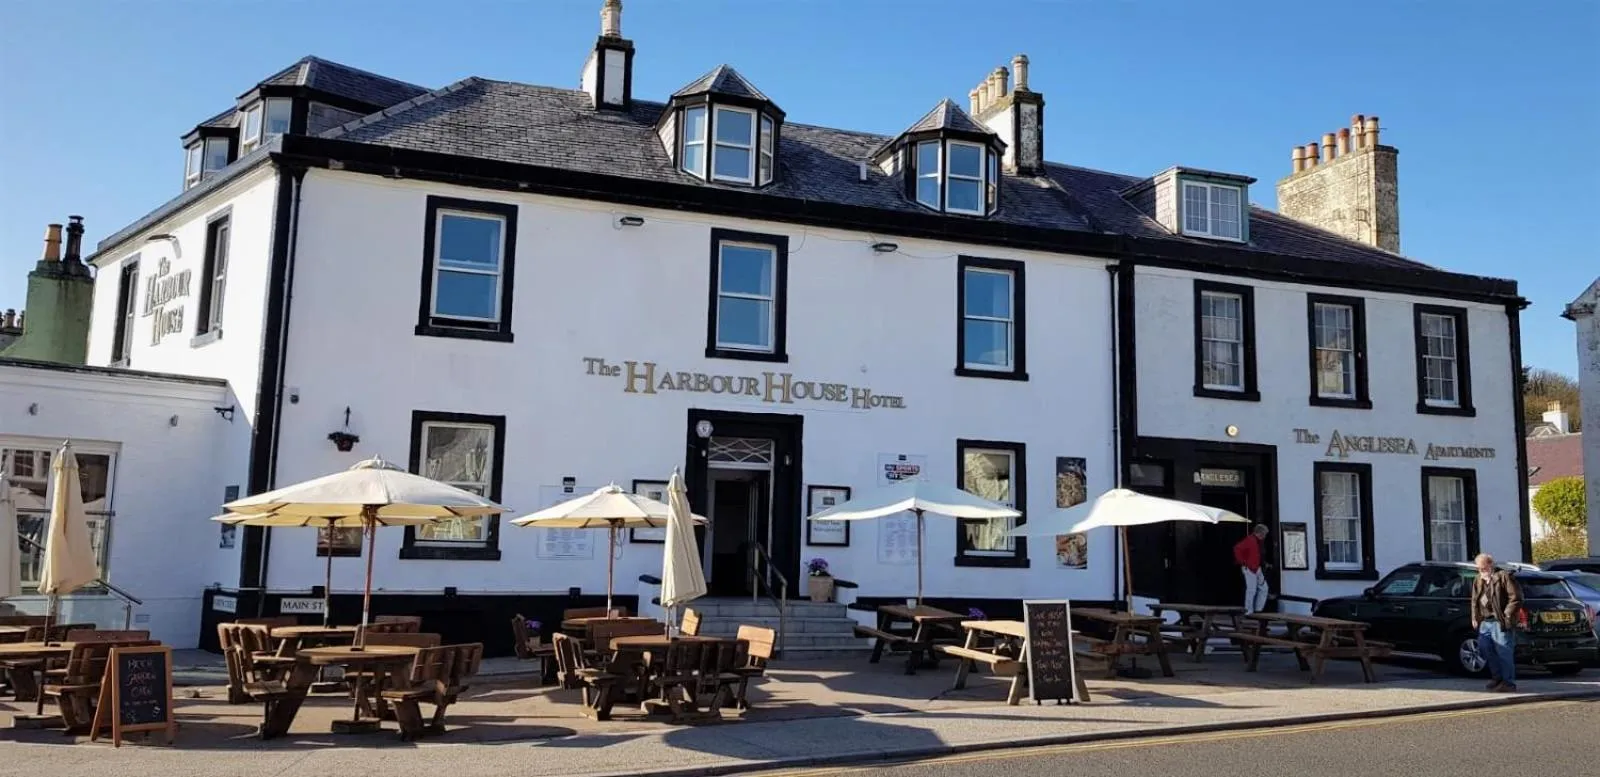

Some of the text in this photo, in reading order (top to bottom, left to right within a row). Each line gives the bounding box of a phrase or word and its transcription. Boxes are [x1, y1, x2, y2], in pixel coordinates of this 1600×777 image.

[159, 257, 170, 278] The
[142, 271, 191, 317] HARBOUR
[151, 305, 184, 347] HOUSE
[583, 357, 907, 409] The HARBOUR HOUSE HOTEL
[1293, 428, 1496, 461] The ANGLESEA APARTMENTS
[282, 600, 323, 610] MAIN ST
